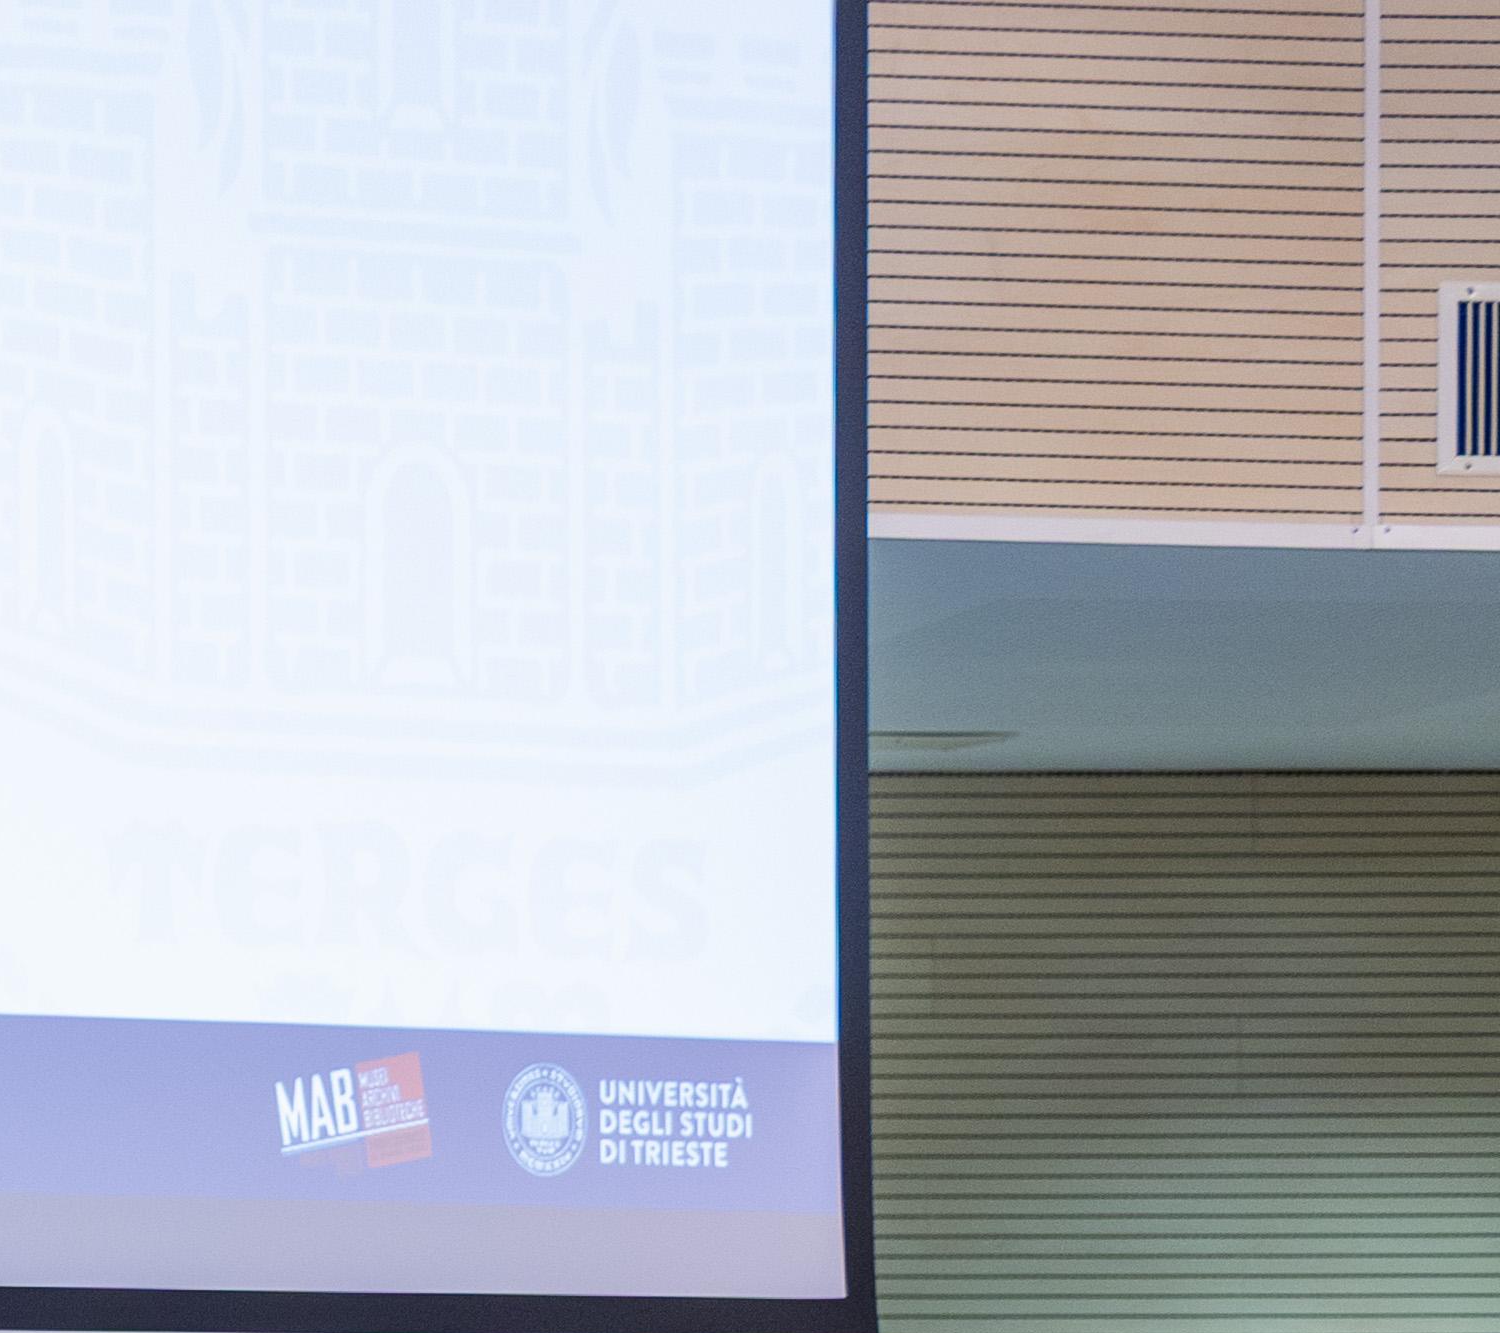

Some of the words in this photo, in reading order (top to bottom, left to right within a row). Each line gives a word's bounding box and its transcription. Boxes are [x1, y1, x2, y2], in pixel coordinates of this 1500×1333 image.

[275, 1067, 359, 1147] MAB
[599, 1077, 748, 1109] UNIVERSITÀ
[599, 1109, 672, 1136] DEGLI
[680, 1112, 754, 1139] STUDI
[599, 1138, 627, 1165] DI
[629, 1139, 729, 1168] TRIESTE
